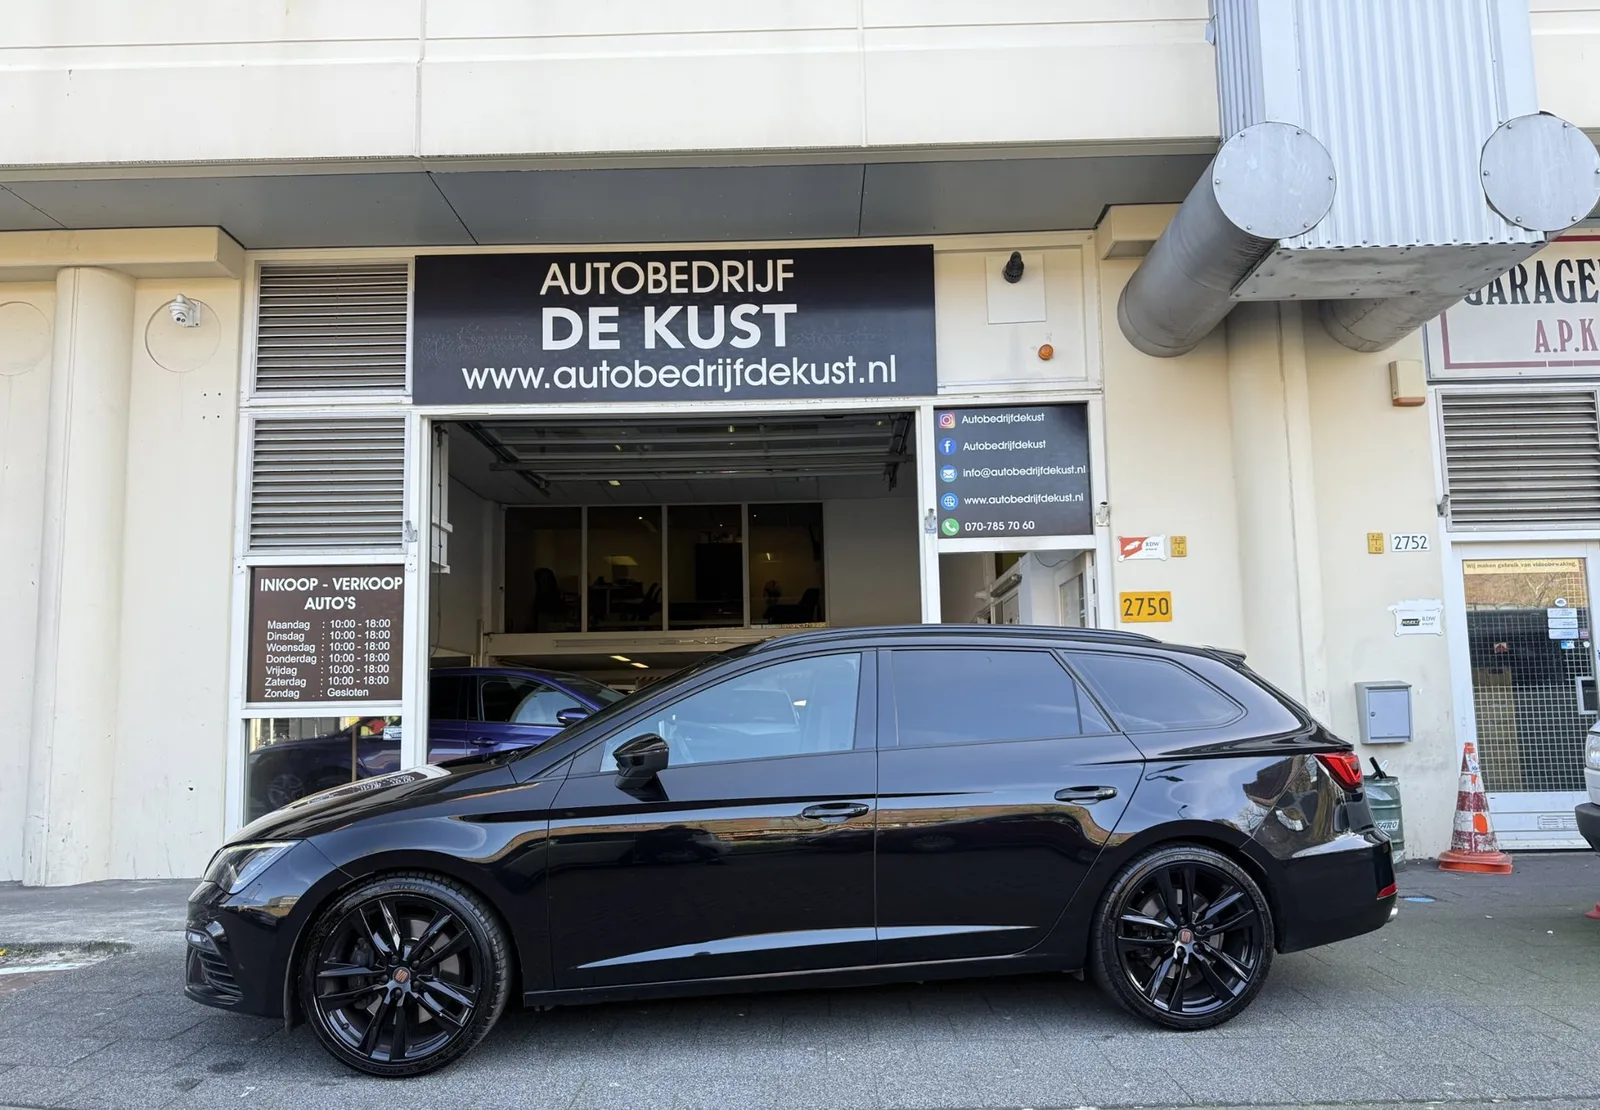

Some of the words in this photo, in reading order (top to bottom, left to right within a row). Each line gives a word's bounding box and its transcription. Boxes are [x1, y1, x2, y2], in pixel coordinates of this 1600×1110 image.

[539, 259, 795, 296] AUTOBEDRIJF
[1463, 258, 1600, 306] ARAGE
[541, 307, 621, 350] DE
[644, 303, 798, 349] KUST
[461, 354, 897, 393] www.autobedrijfdekust.nl
[961, 412, 1045, 425] Autobedrijfdekust
[963, 439, 1047, 451] Autobedrijfdekust
[962, 464, 1086, 478] info@autobedrijfdekust.nl
[963, 492, 1084, 506] www.autobedrijfdekust.nl
[964, 521, 1005, 531] 070-785
[1008, 521, 1020, 531] 70
[1022, 520, 1035, 530] 60
[1394, 535, 1428, 550] 2752
[260, 578, 318, 591] INKOOP
[332, 577, 403, 590] VERKOOP
[304, 597, 356, 610] AUTO'S
[1123, 597, 1169, 616] 2750
[267, 620, 310, 630] Maandag
[330, 619, 355, 628] 10:00
[365, 619, 391, 628] 18:00
[267, 632, 304, 642] Dinsdag
[329, 631, 355, 639] 10:00
[364, 630, 390, 639] 18:00
[267, 643, 315, 653] Woensdag
[329, 642, 355, 651] 10:00
[364, 642, 390, 650] 18:00
[266, 655, 317, 665] Donderdag
[329, 654, 355, 662] 10:00
[364, 653, 390, 662] 18:00
[266, 666, 297, 676] Vrijdag
[328, 665, 354, 673] 10:00
[363, 665, 389, 673] 18:00
[265, 678, 306, 688] Zaterdag
[328, 677, 354, 685] 10:00
[363, 676, 389, 685] 18:00
[264, 689, 300, 699] Zondag
[327, 688, 369, 697] Gesloten
